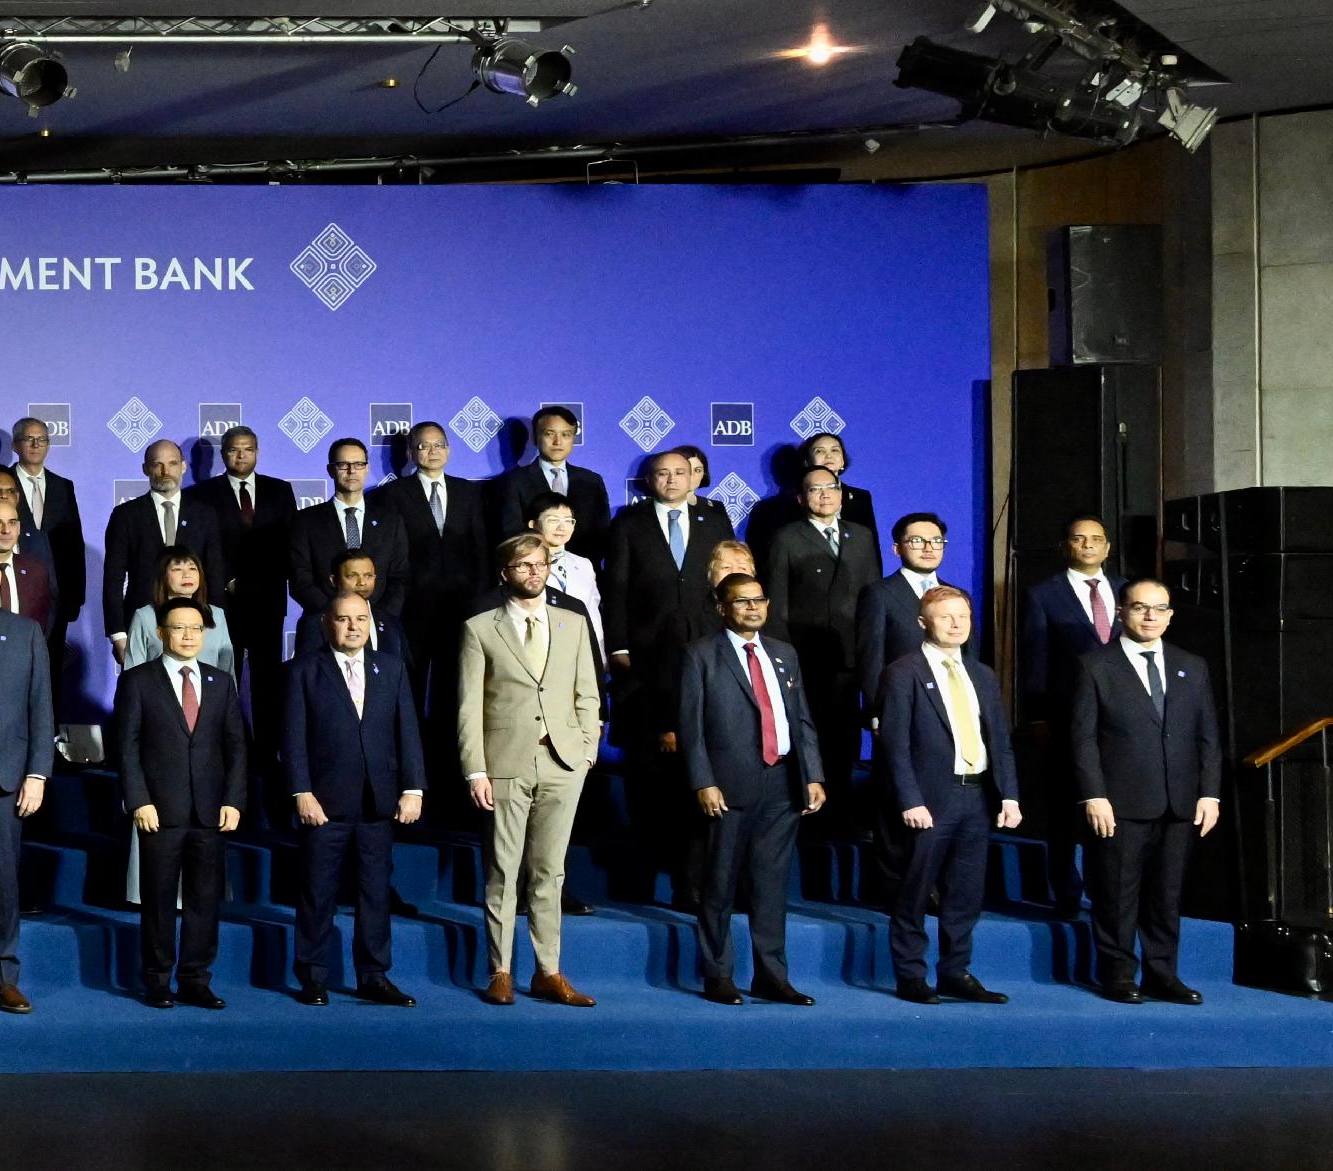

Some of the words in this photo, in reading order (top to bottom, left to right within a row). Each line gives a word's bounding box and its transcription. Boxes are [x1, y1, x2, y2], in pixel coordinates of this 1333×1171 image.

[134, 256, 256, 291] BANK
[45, 421, 69, 437] DB
[714, 420, 752, 435] ADB
